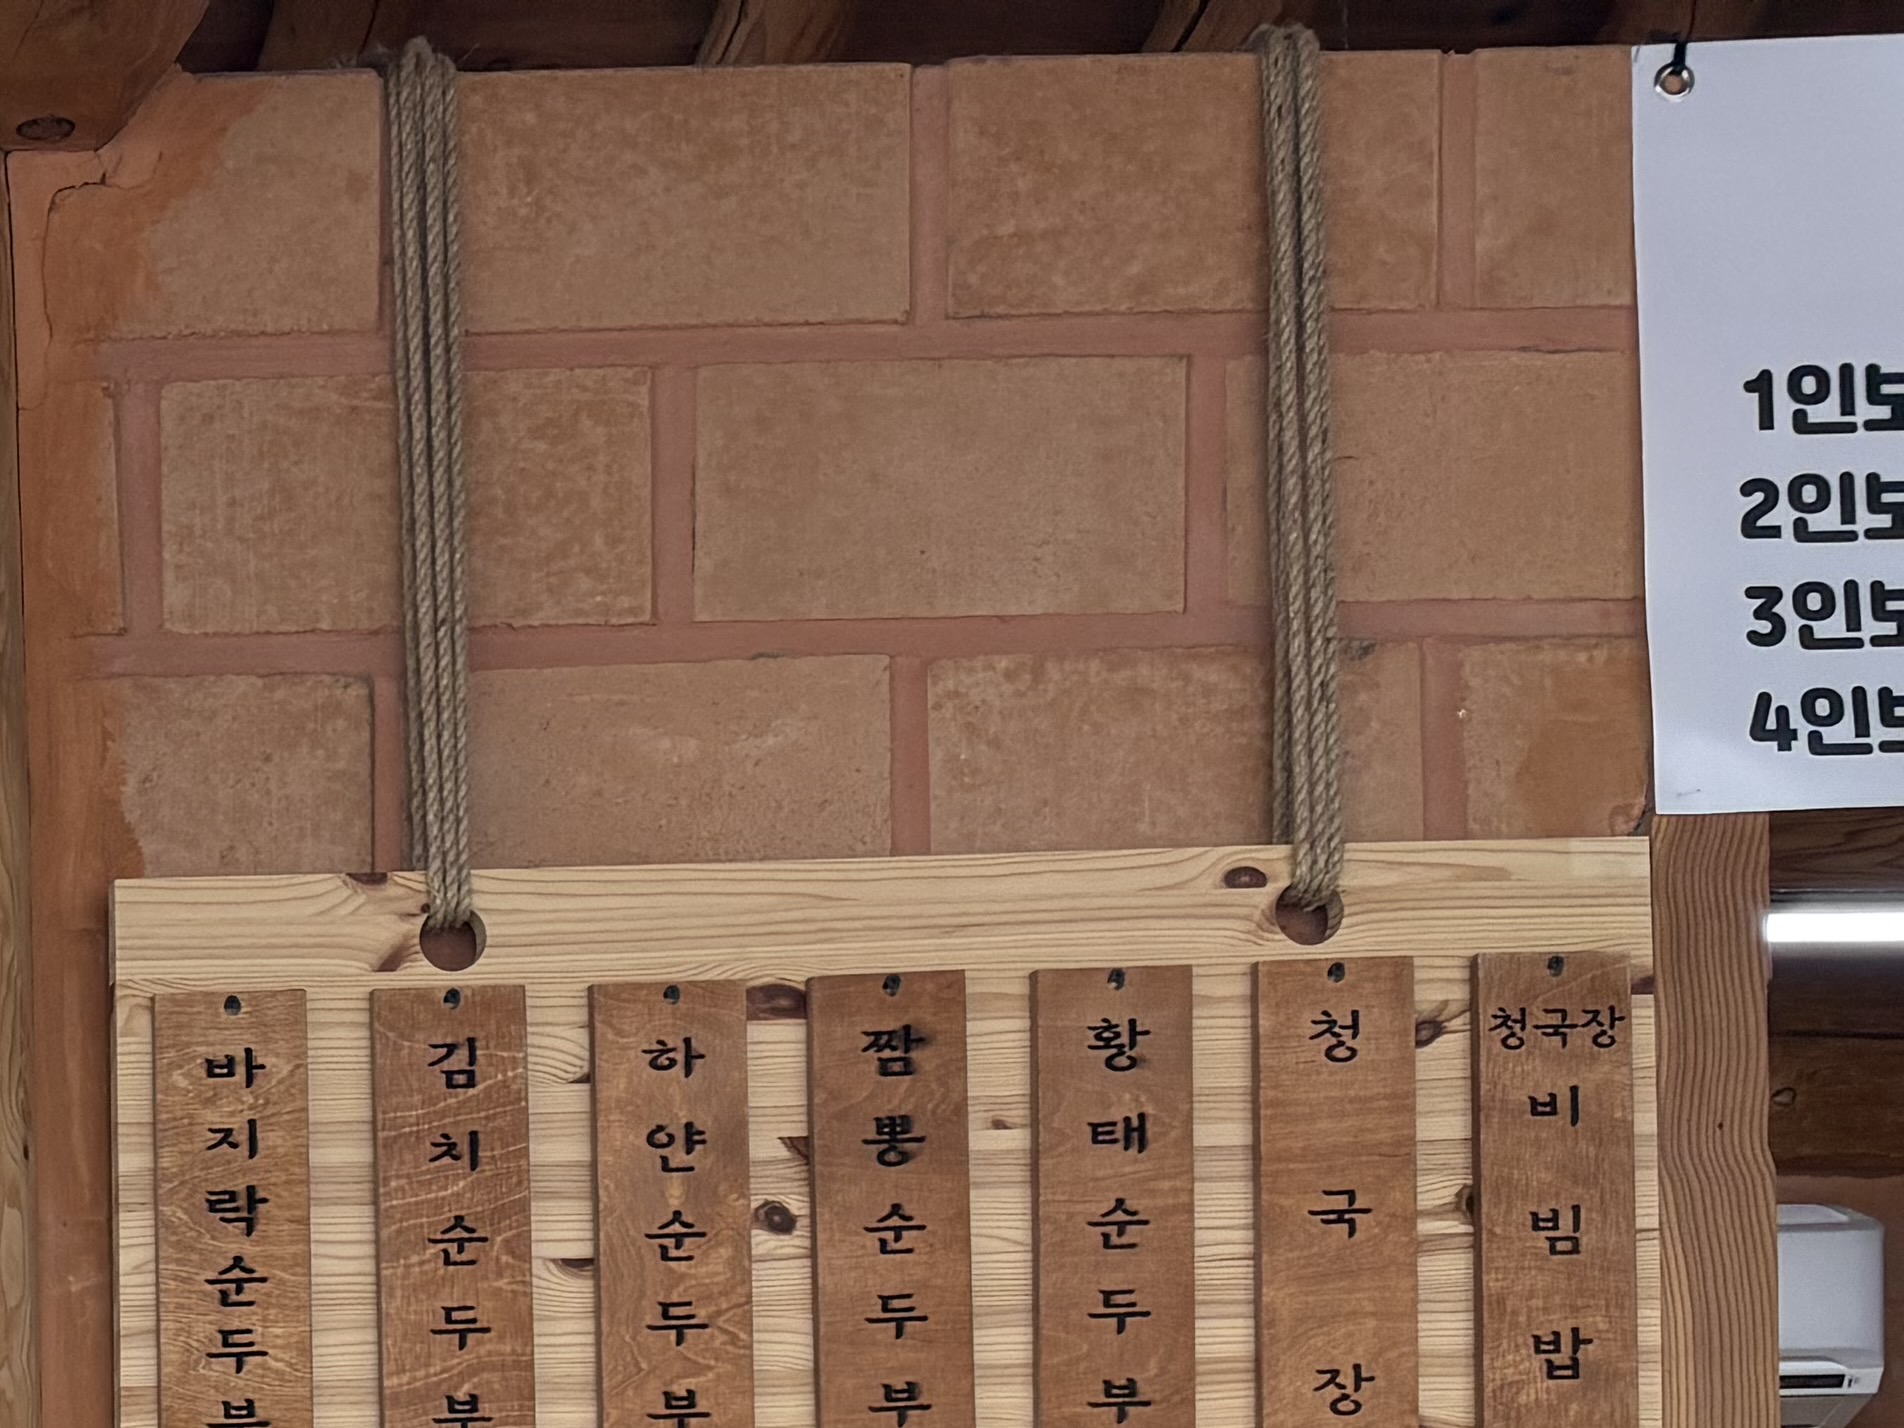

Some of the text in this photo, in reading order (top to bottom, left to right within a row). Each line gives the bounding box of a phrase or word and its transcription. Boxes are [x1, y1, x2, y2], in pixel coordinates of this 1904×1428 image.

[860, 1023, 933, 1428] 짬뽕순두부
[1085, 1017, 1153, 1424] 황태순두부
[1307, 1009, 1376, 1417] 청국장
[1487, 1004, 1626, 1382] 청국장 비빔밥
